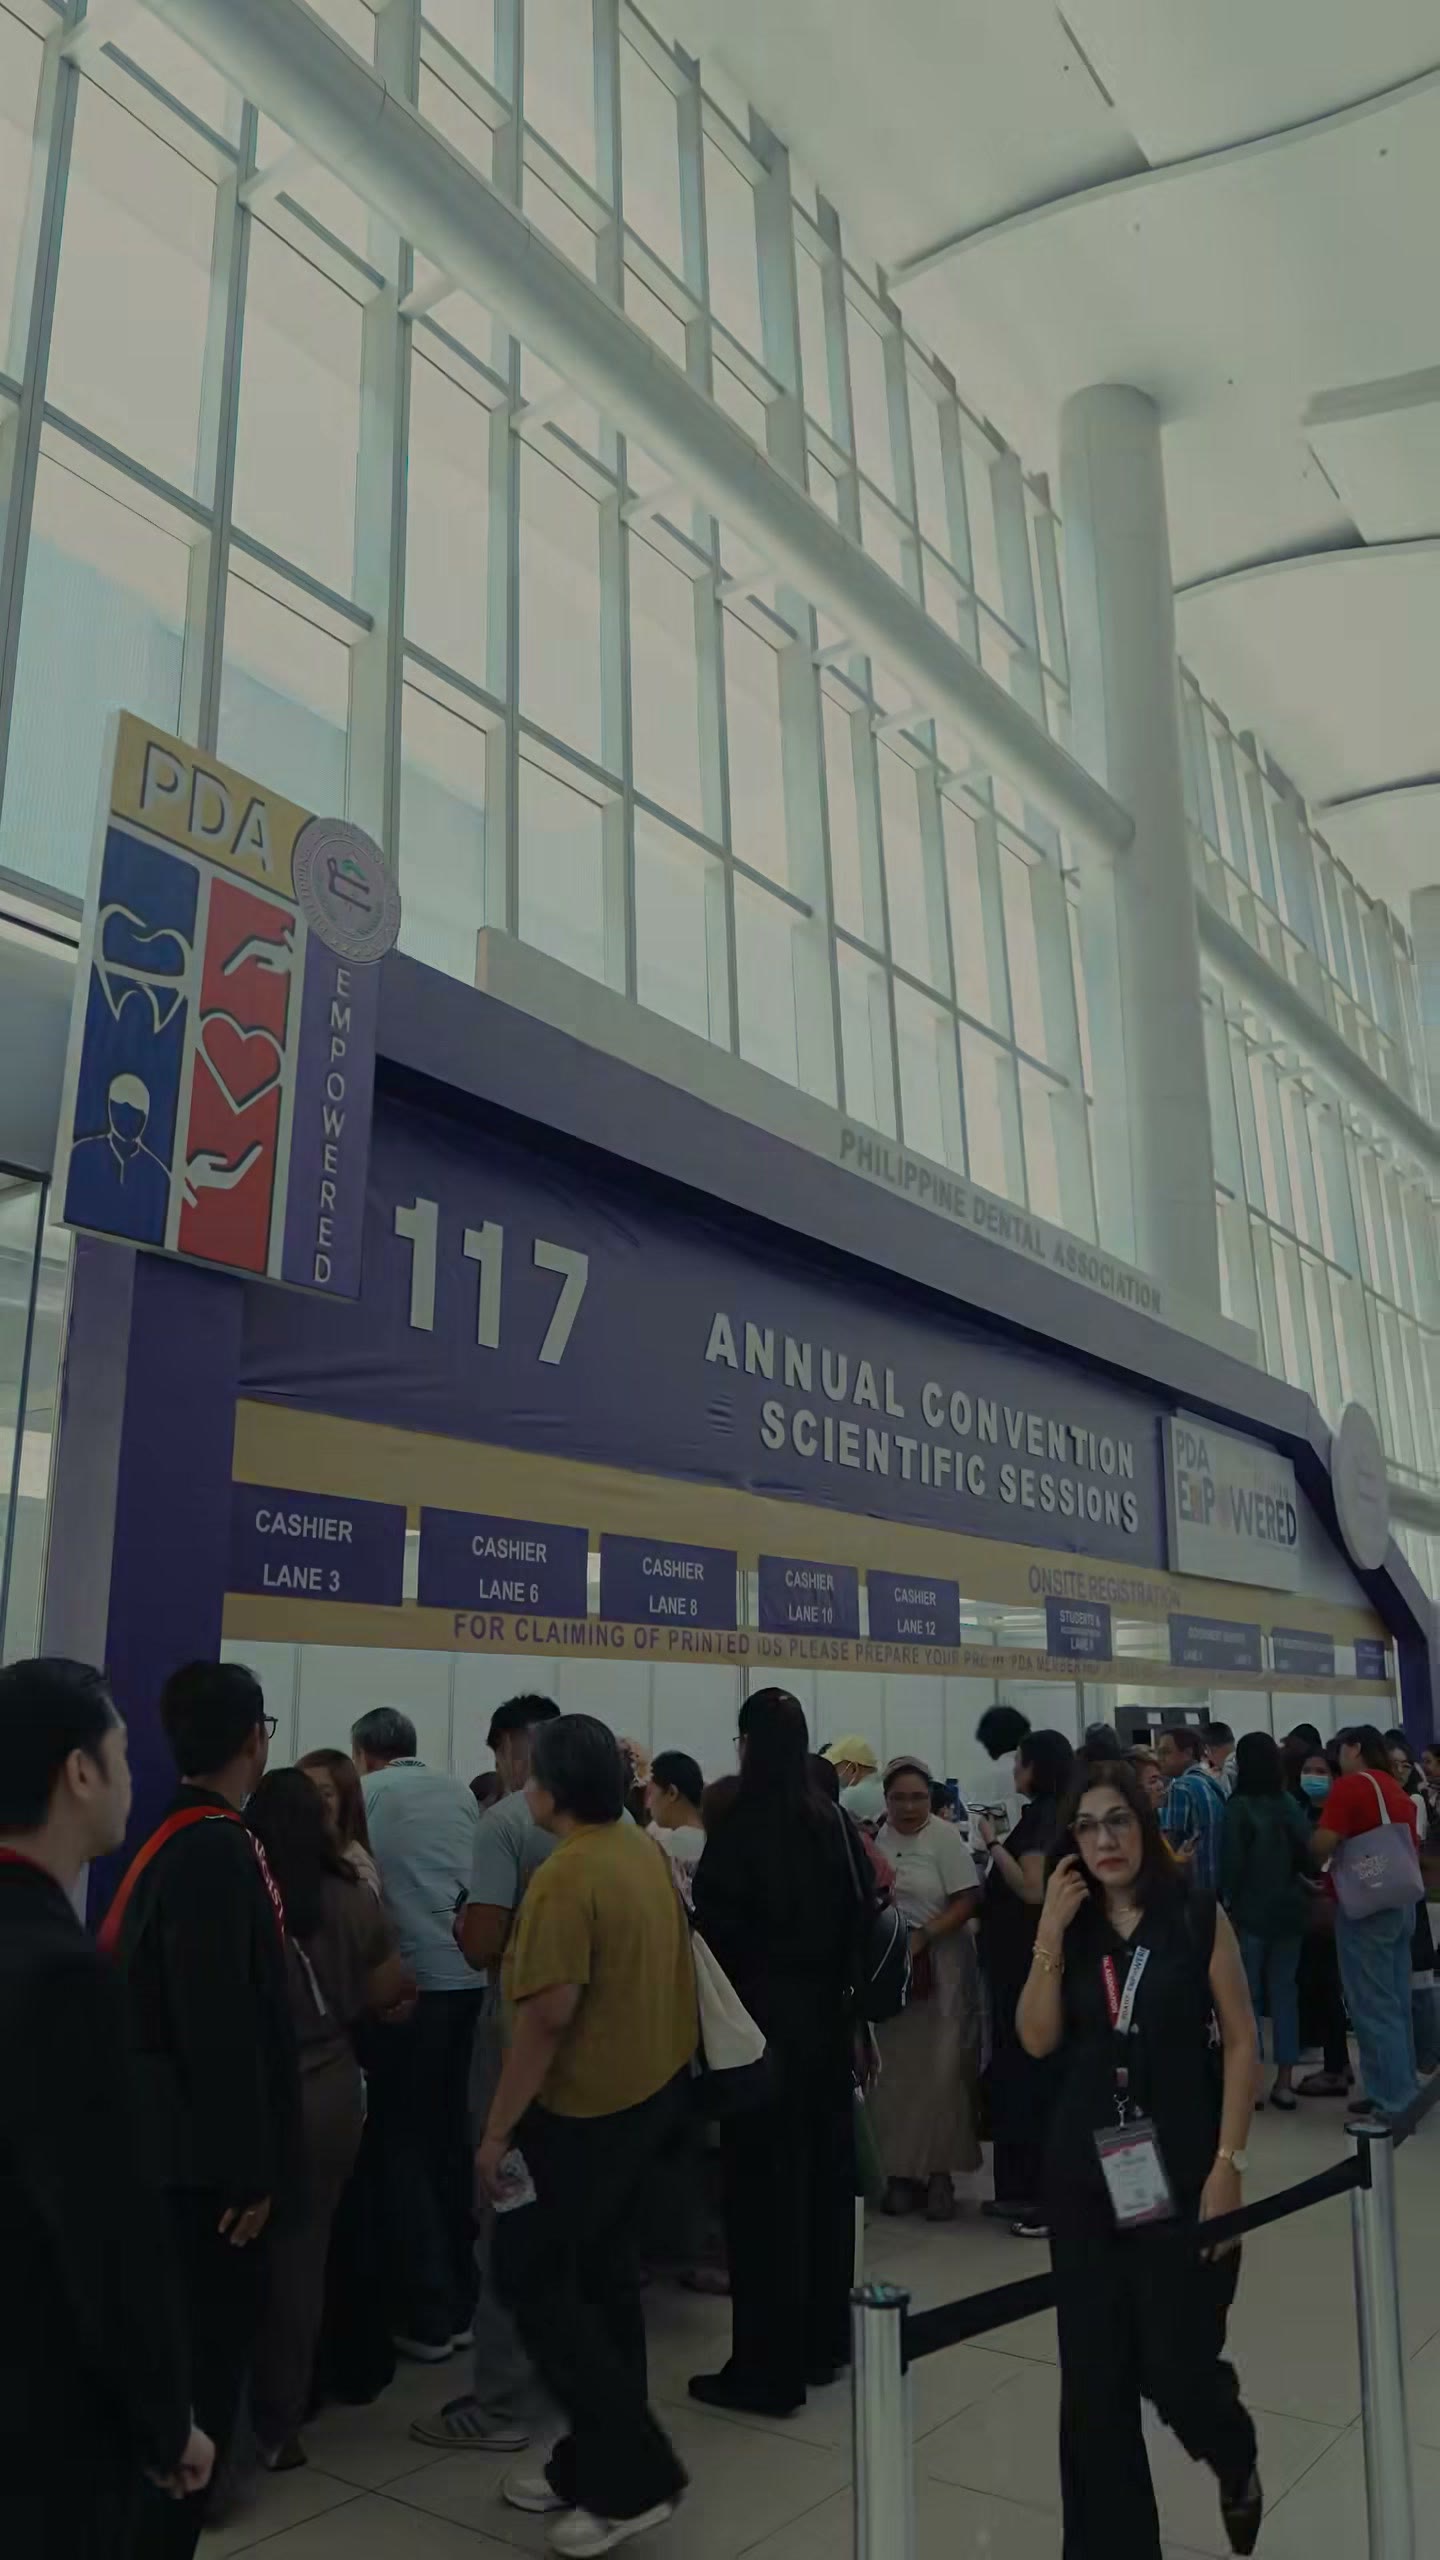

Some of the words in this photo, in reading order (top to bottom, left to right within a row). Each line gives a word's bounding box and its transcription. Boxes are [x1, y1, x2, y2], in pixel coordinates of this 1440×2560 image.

[140, 740, 272, 872] PDA
[312, 967, 351, 1284] EMPOWERED
[839, 1128, 966, 1219] PHILIPPINE
[973, 1194, 1046, 1260] DENTAL
[1053, 1240, 1162, 1314] ASSOCIATION
[395, 1197, 589, 1365] 117
[704, 1312, 905, 1419] ANNUAL
[921, 1382, 1135, 1480] CONVENTION
[760, 1400, 987, 1496] SCIENTIFIC
[999, 1464, 1139, 1534] SESSIONS
[1175, 1429, 1210, 1474] PDA
[255, 1509, 353, 1544] CASHIER
[471, 1535, 548, 1564] CASHIER
[263, 1563, 322, 1592] LANE
[329, 1569, 340, 1593] 3
[642, 1556, 704, 1581] CASHIER
[785, 1569, 834, 1591] CASHIER
[1028, 1565, 1086, 1599] ONSITE
[479, 1578, 525, 1602] LANE
[529, 1583, 539, 1604] 6
[649, 1595, 687, 1616] LANE
[690, 1598, 698, 1617] 8
[894, 1587, 937, 1607] CASHIER
[788, 1604, 819, 1624] LANE
[821, 1607, 833, 1625] 10
[897, 1617, 924, 1635] LANE
[925, 1619, 936, 1636] 12
[454, 1613, 504, 1641] FOR
[515, 1618, 625, 1648] CLAIMING
[634, 1626, 660, 1649] OF
[668, 1629, 750, 1655] PRINTED
[757, 1637, 782, 1658] IDS
[789, 1639, 849, 1662] PLEASE
[855, 1642, 919, 1665] PREPARE
